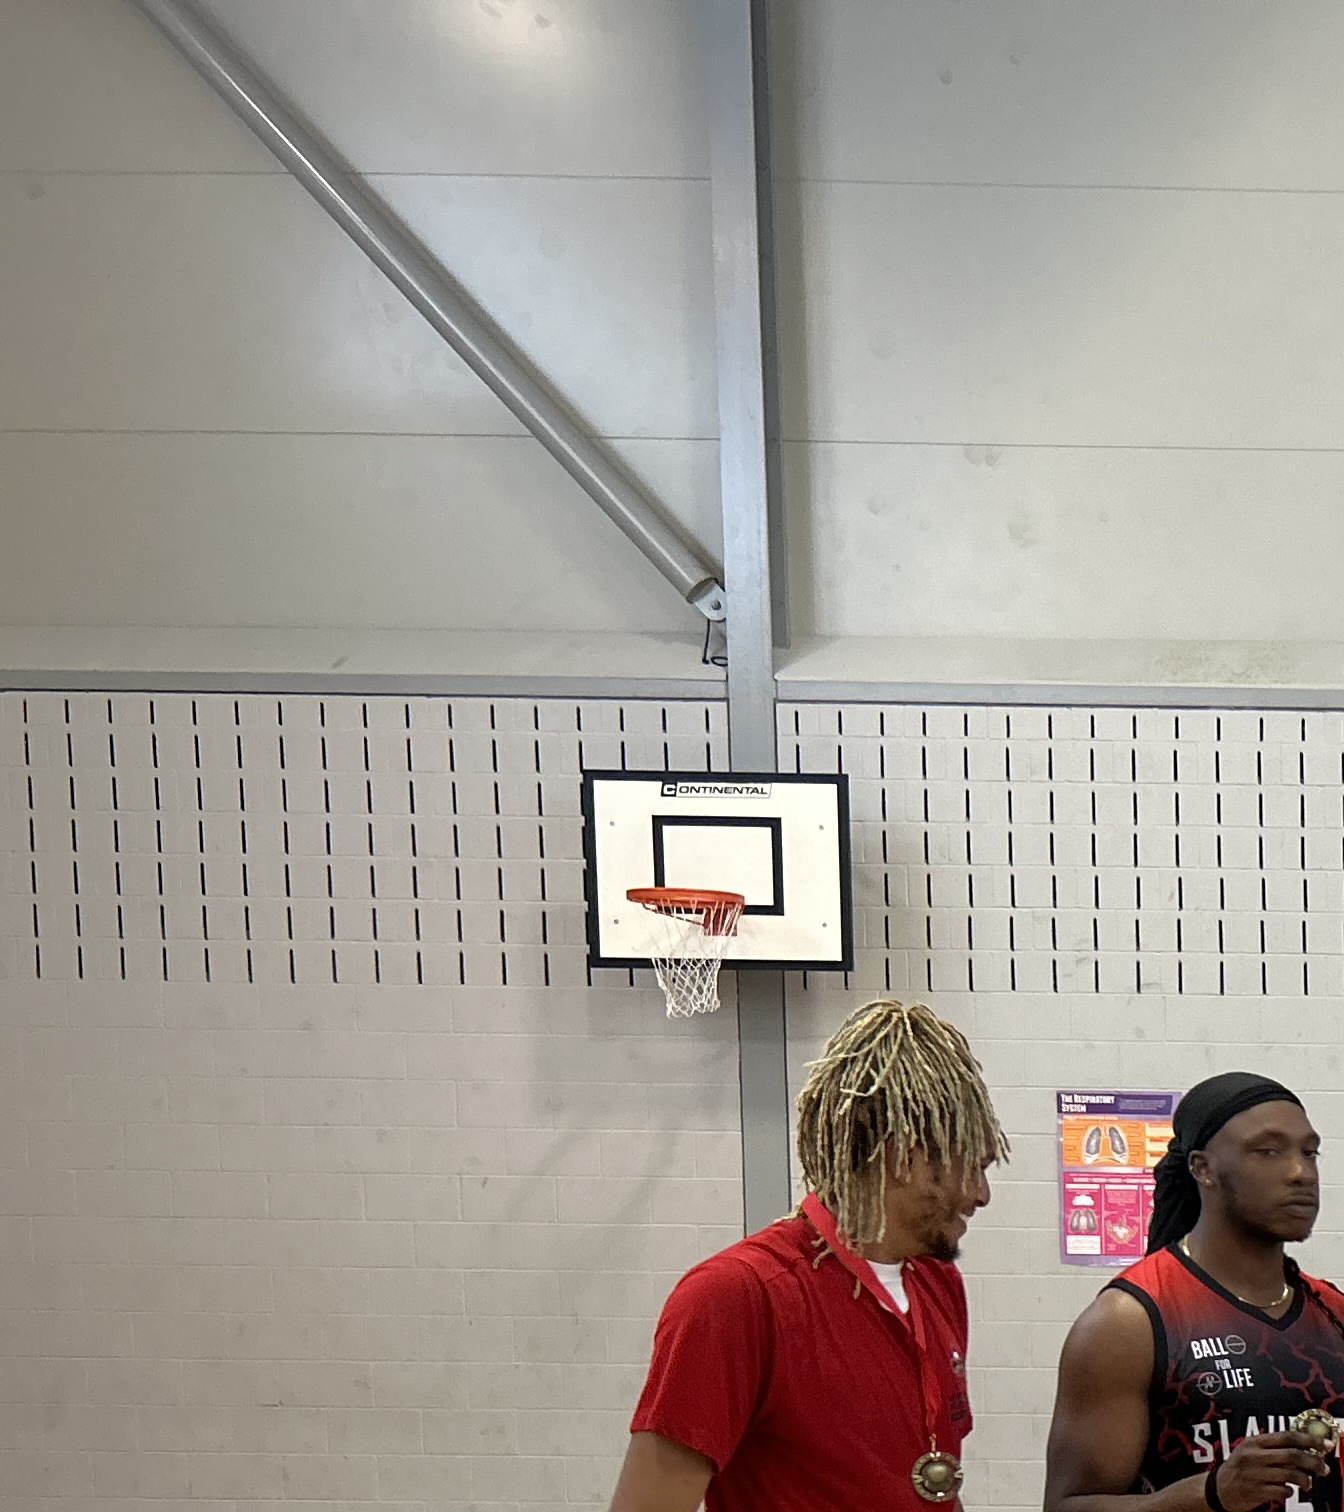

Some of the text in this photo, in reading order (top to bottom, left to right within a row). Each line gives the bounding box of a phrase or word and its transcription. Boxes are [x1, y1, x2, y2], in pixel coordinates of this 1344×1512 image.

[661, 781, 768, 797] CONTINENTAL
[1191, 1337, 1229, 1360] BALL
[1215, 1359, 1231, 1370] FOR
[1223, 1368, 1254, 1389] LIFE
